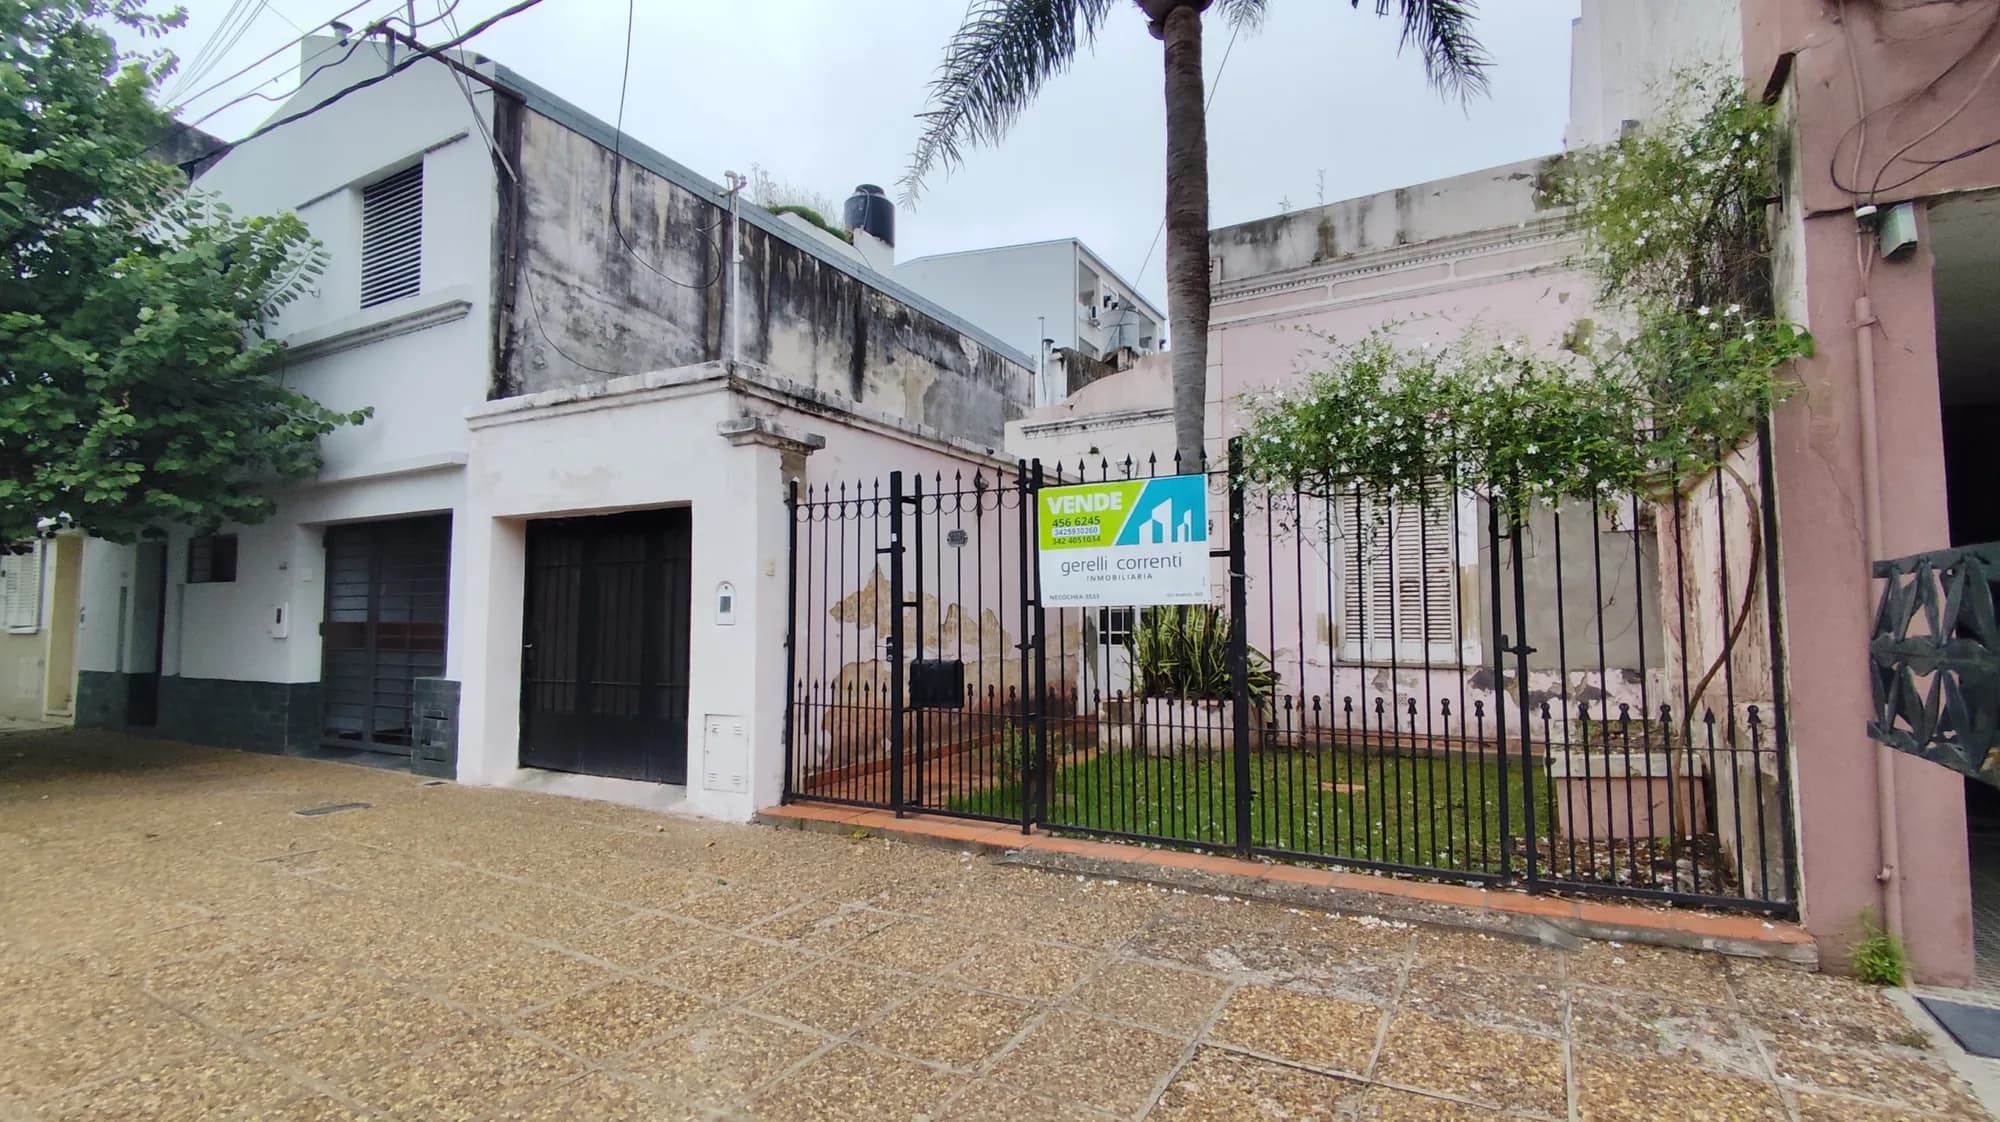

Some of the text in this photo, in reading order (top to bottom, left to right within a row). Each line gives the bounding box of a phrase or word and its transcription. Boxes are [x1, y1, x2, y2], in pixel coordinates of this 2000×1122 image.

[1047, 492, 1123, 515] VENDE
[1052, 516, 1101, 528] 456 6245
[1053, 537, 1066, 545] 342
[1061, 552, 1182, 576] gerelli correnti
[1086, 573, 1153, 582] INMOBILIARIA
